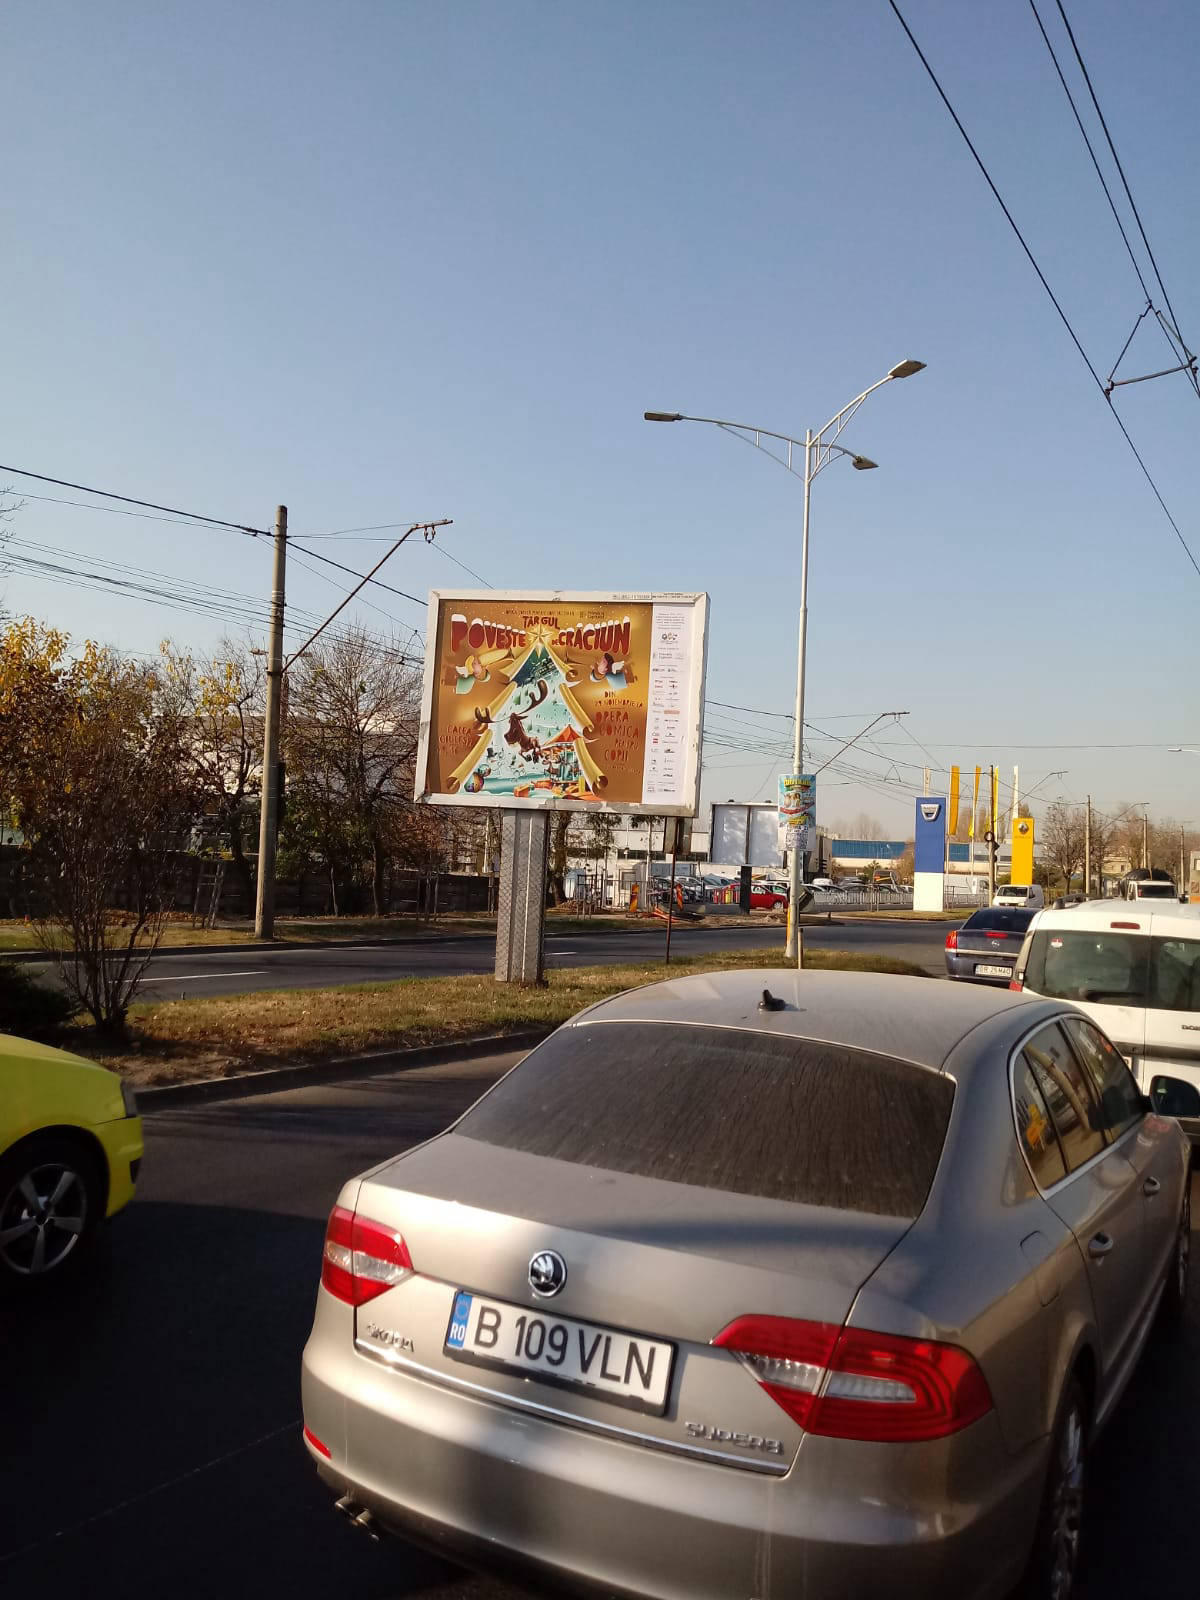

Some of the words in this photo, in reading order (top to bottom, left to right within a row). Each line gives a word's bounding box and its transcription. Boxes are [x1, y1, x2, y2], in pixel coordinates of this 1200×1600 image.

[451, 614, 526, 653] POVESTE
[596, 711, 629, 722] OPERA
[449, 1322, 465, 1341] RO
[475, 1306, 501, 1348] B
[514, 1315, 569, 1367] 109
[579, 1328, 656, 1390] VLN
